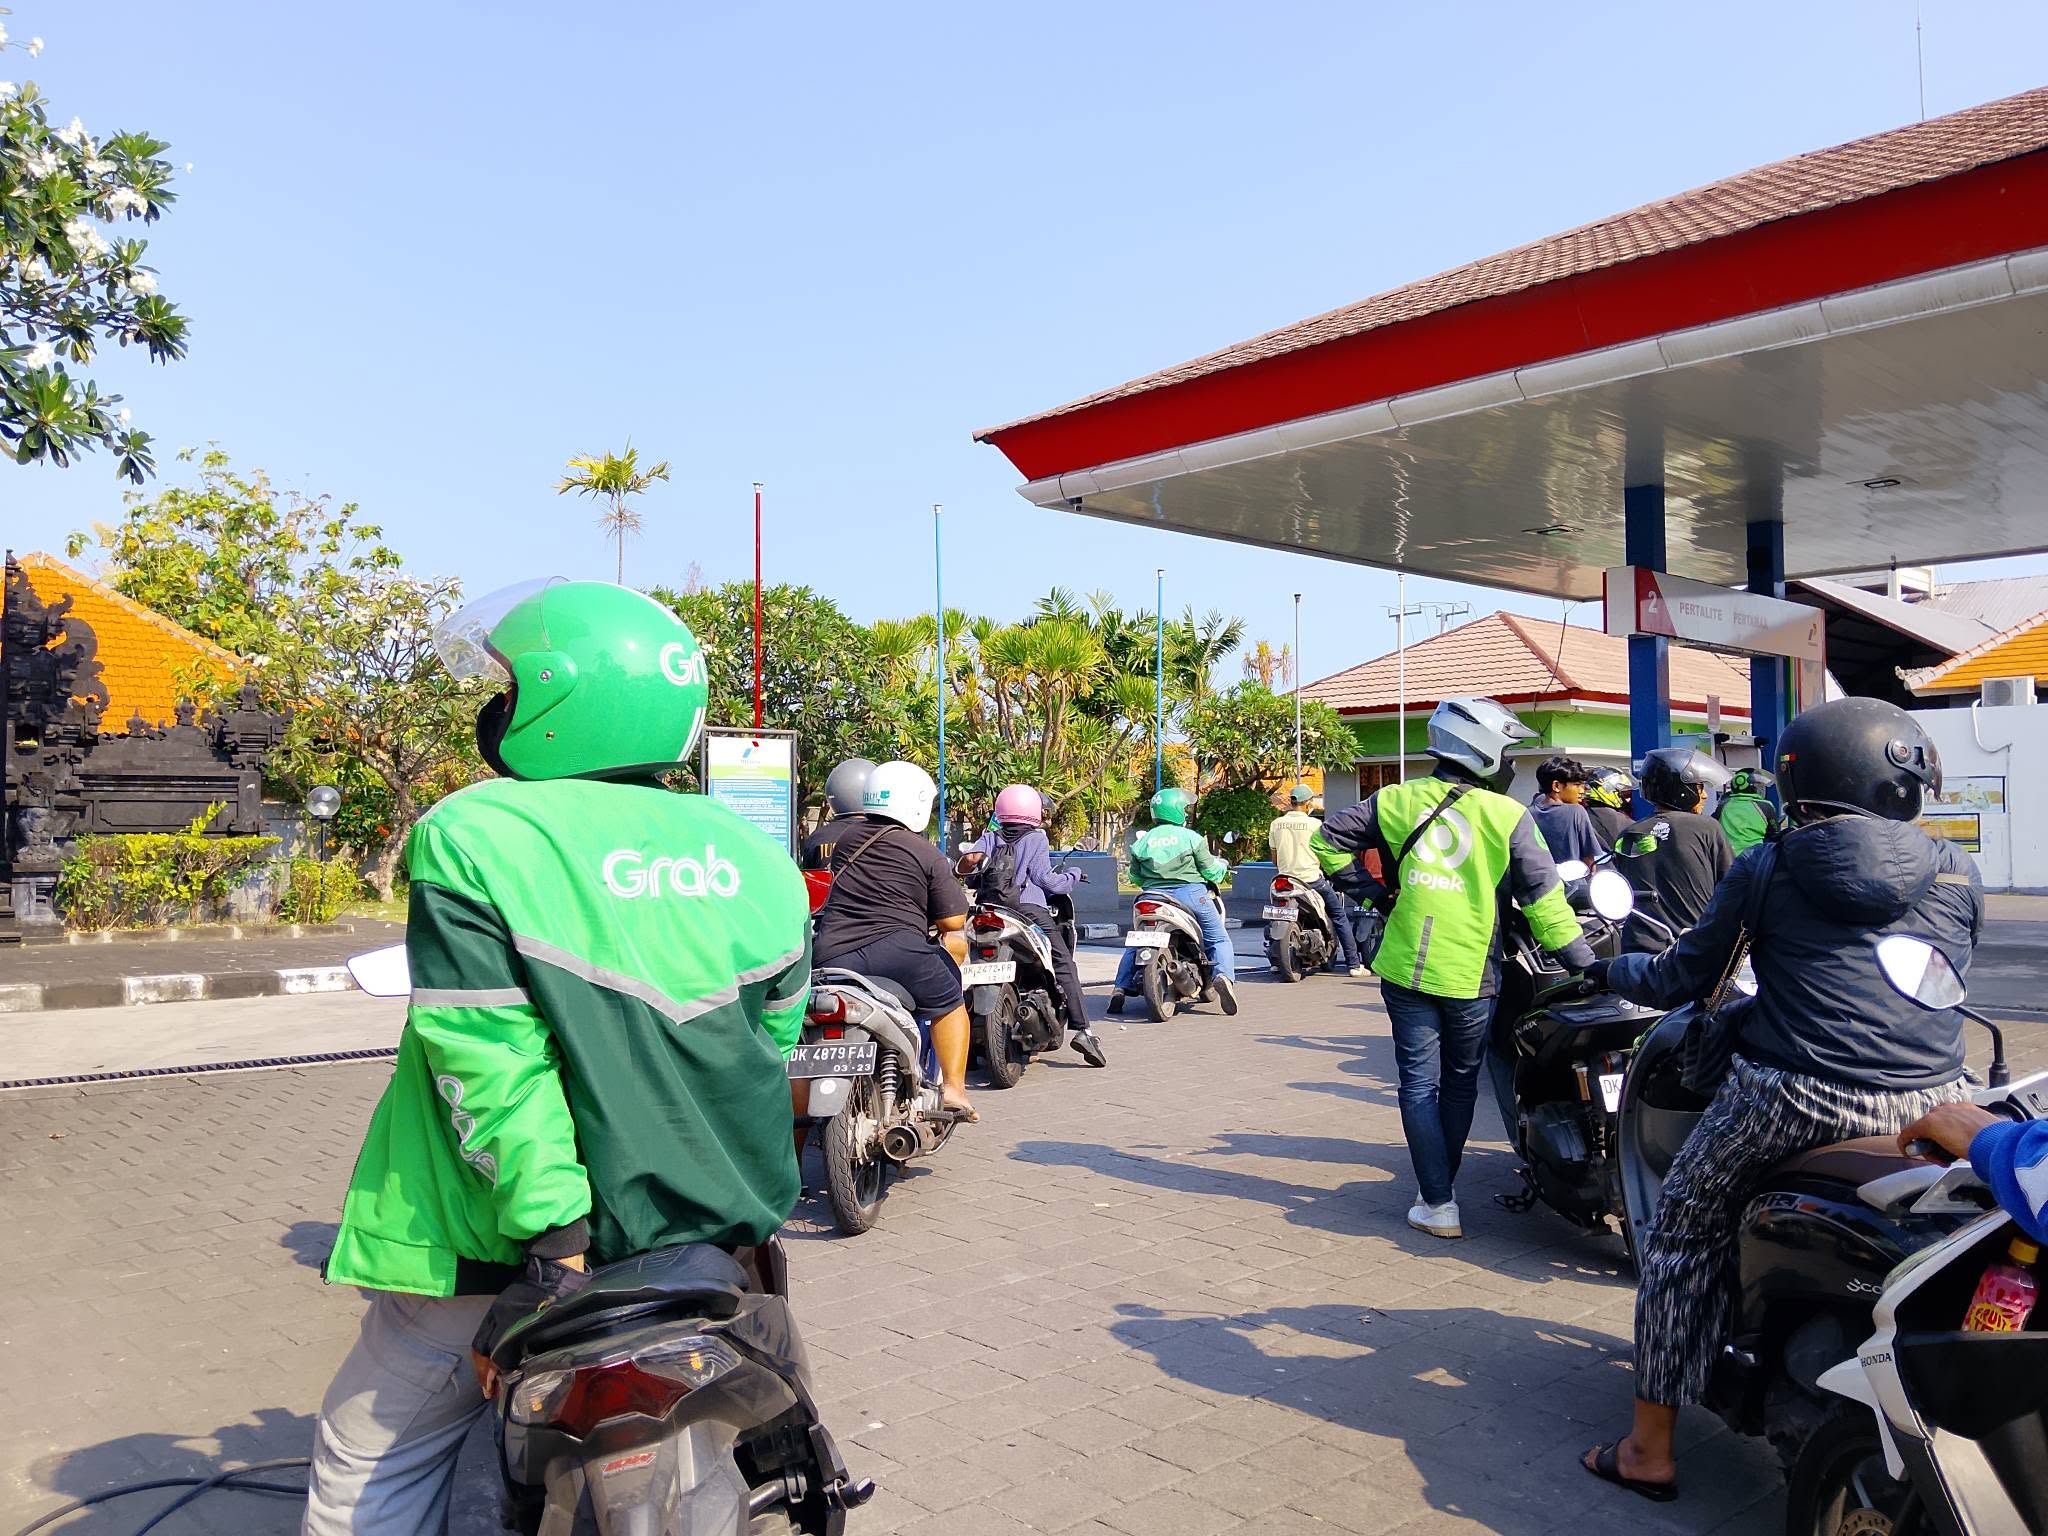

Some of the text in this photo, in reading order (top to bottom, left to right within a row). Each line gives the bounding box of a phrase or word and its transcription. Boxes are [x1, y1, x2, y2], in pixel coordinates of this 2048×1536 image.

[1648, 590, 1658, 614] 2
[1679, 602, 1723, 621] PERTALITE
[1147, 835, 1179, 848] Grab
[602, 845, 741, 899] Grab
[1408, 868, 1465, 893] gojek
[790, 1045, 874, 1062] DK 4879 FAJ
[1603, 1079, 1621, 1094] DK
[1860, 1352, 1893, 1369] HONDA
